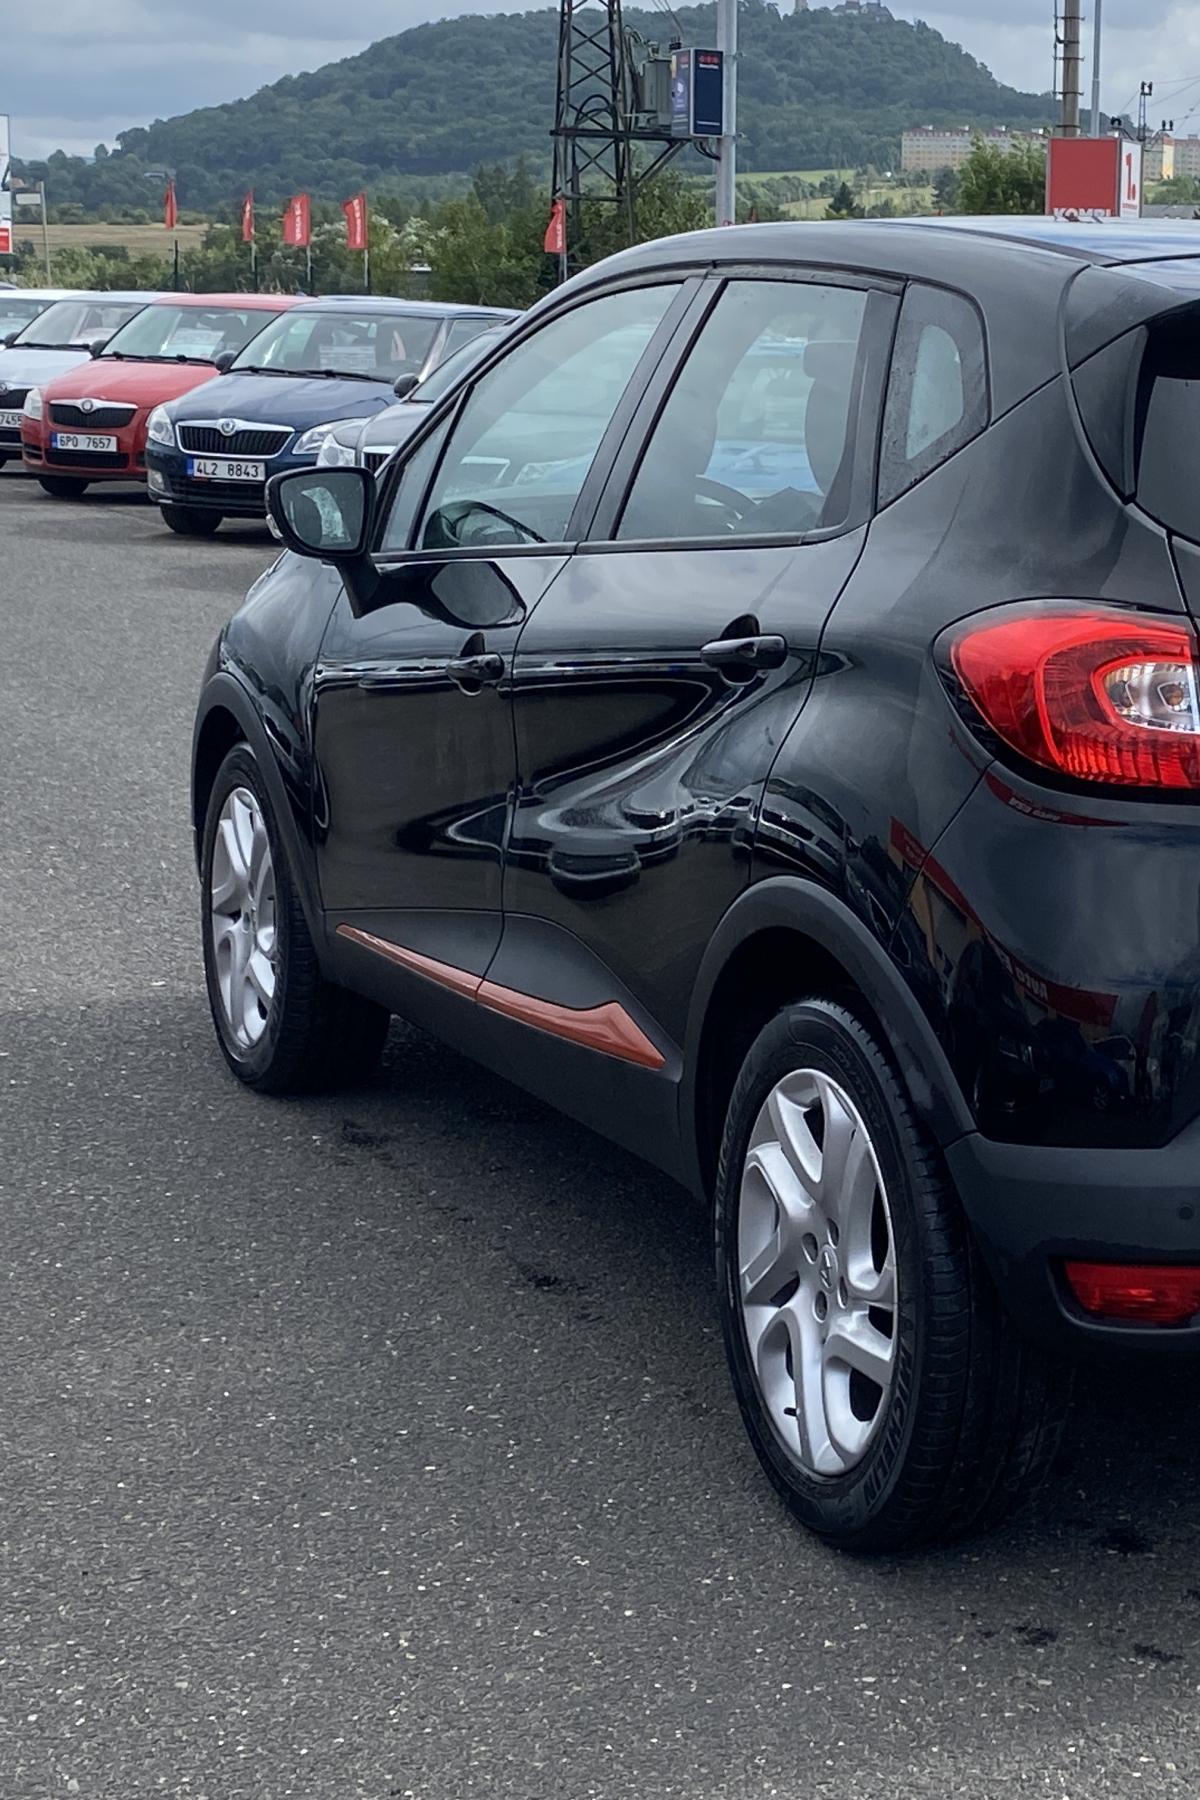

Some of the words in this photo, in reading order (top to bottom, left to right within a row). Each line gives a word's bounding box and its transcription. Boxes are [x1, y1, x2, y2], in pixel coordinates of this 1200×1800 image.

[86, 436, 112, 449] 7657
[196, 461, 218, 476] 4L2
[227, 463, 259, 478] 8843
